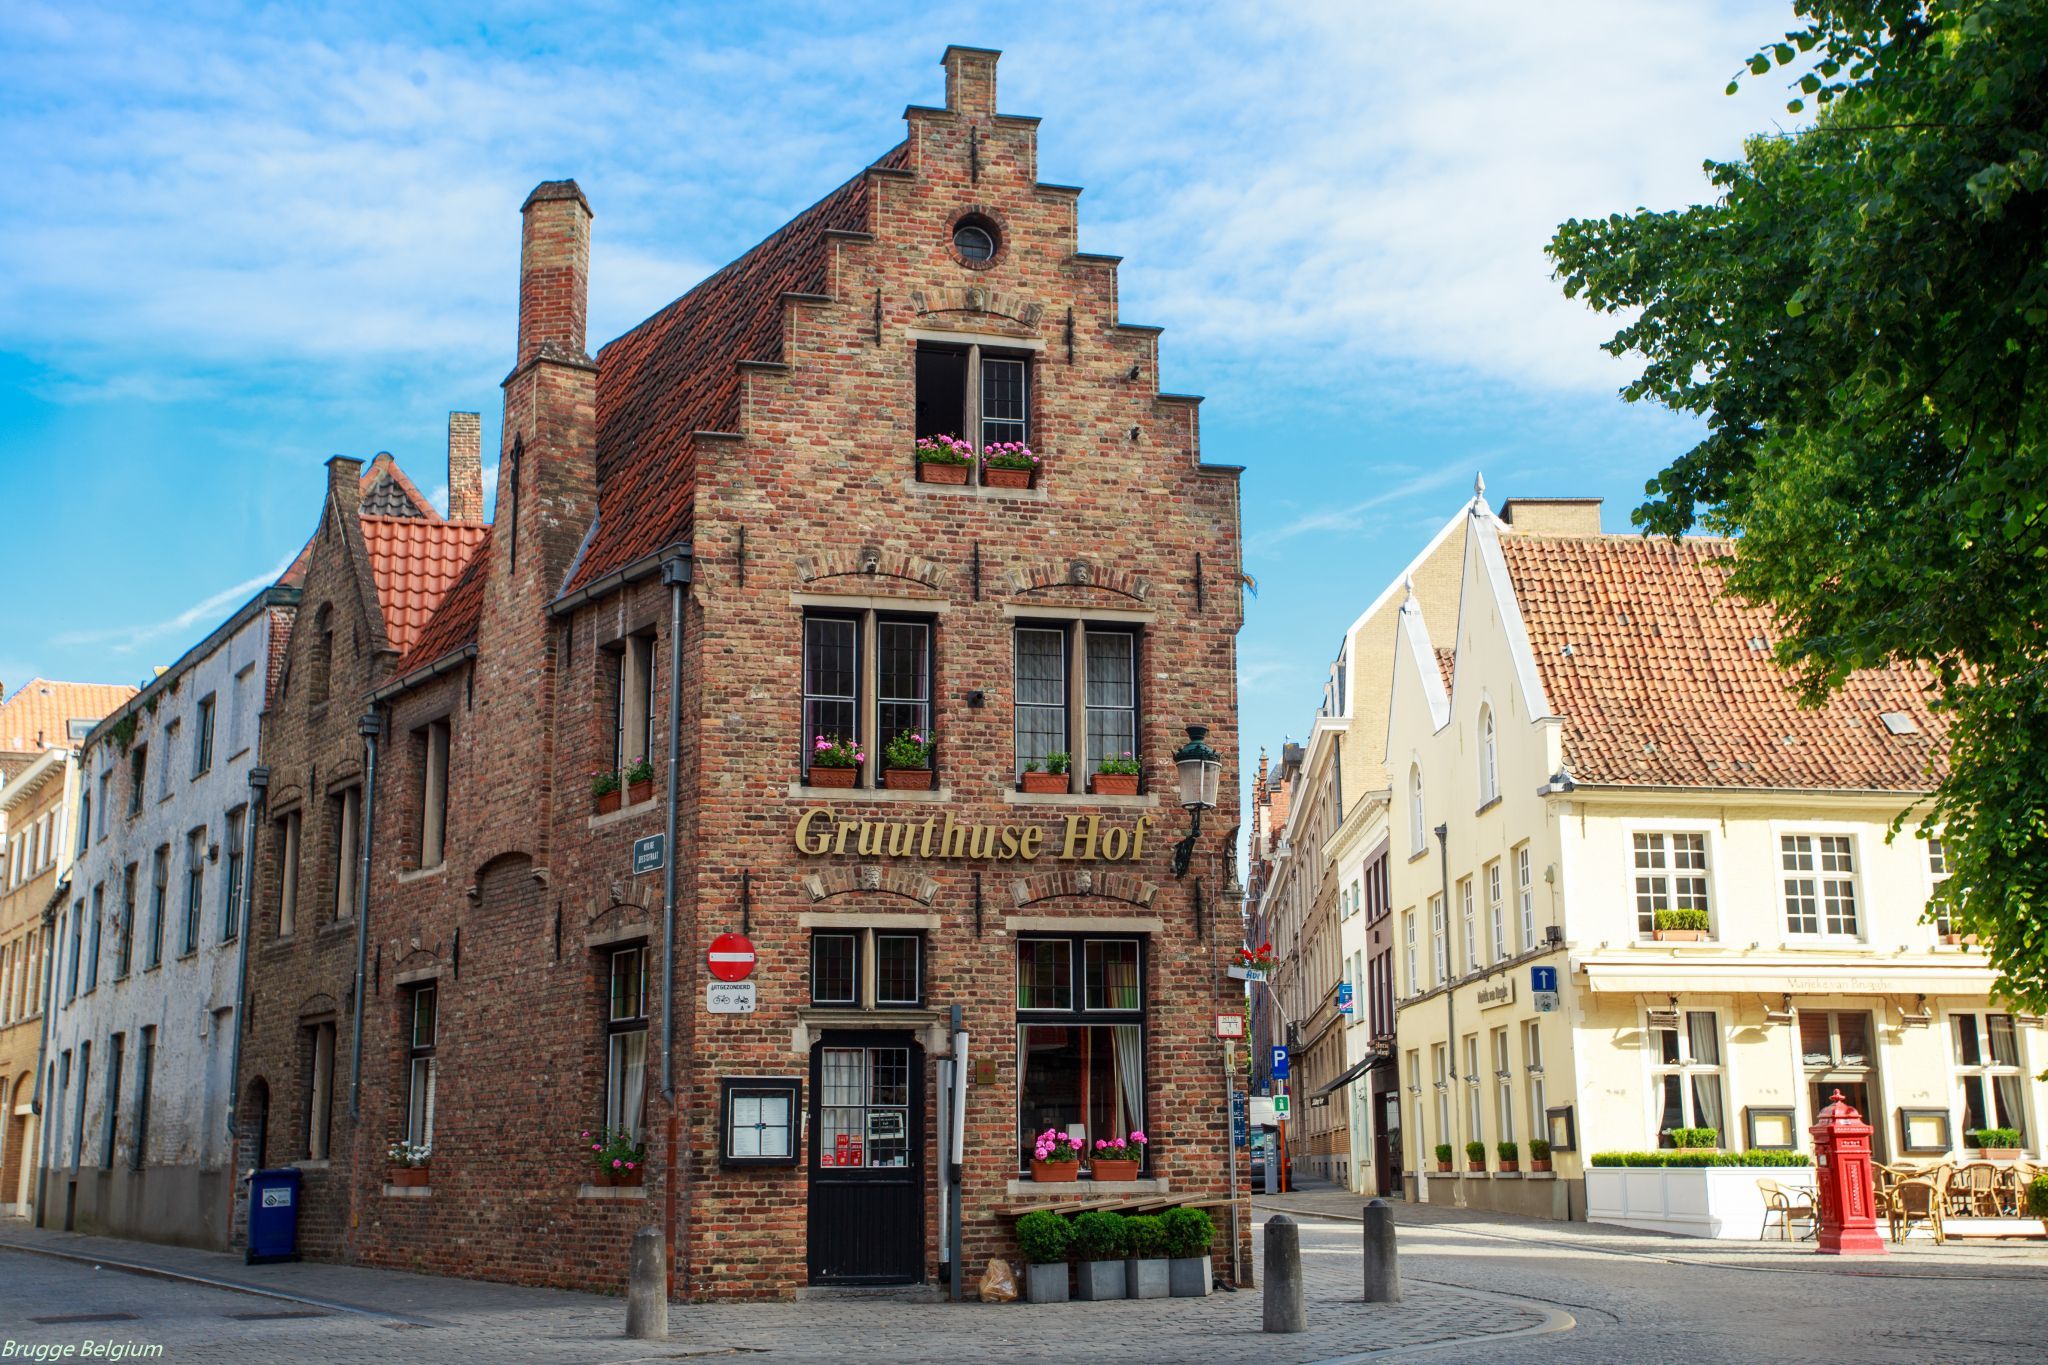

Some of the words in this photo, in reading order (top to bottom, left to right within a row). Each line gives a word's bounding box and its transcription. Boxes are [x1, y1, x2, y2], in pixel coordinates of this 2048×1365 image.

[795, 806, 1042, 860] Gruuthuse
[1058, 813, 1150, 861] Hof
[1274, 1050, 1286, 1067] P
